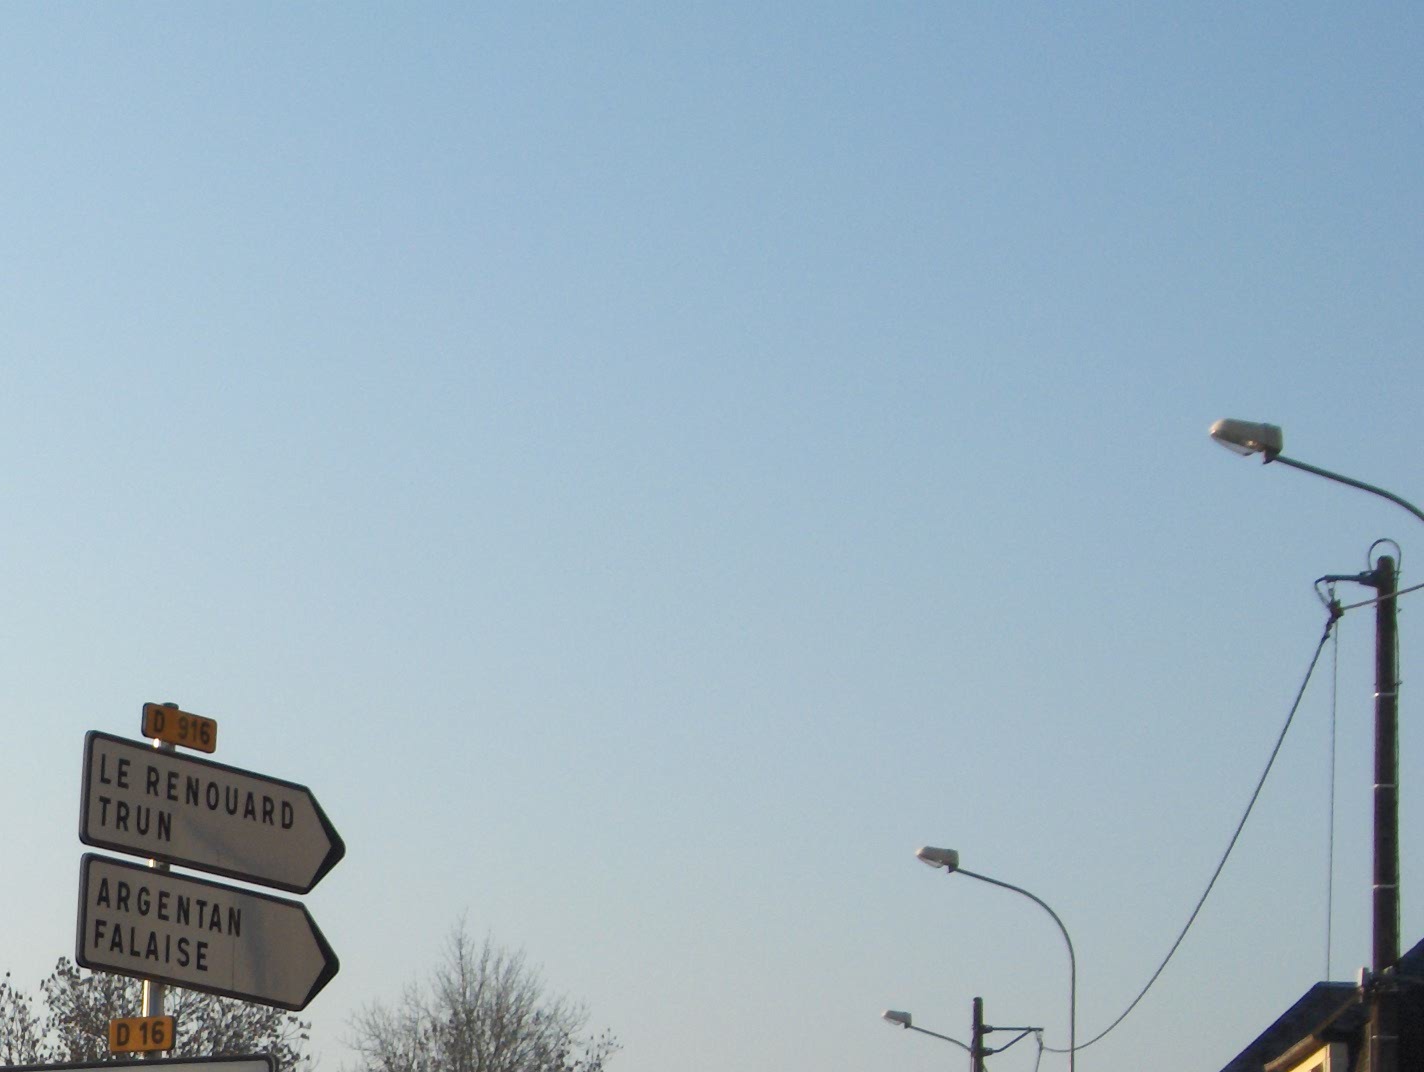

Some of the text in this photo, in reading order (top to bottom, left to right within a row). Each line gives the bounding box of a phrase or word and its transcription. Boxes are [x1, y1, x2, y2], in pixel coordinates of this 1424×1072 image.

[153, 709, 211, 745] D 916
[99, 753, 294, 829] LE RENOUARD
[98, 796, 172, 842] TRUN
[96, 878, 241, 937] ARGENTAN
[94, 919, 208, 971] FALAISE
[116, 1021, 164, 1046] D 16
